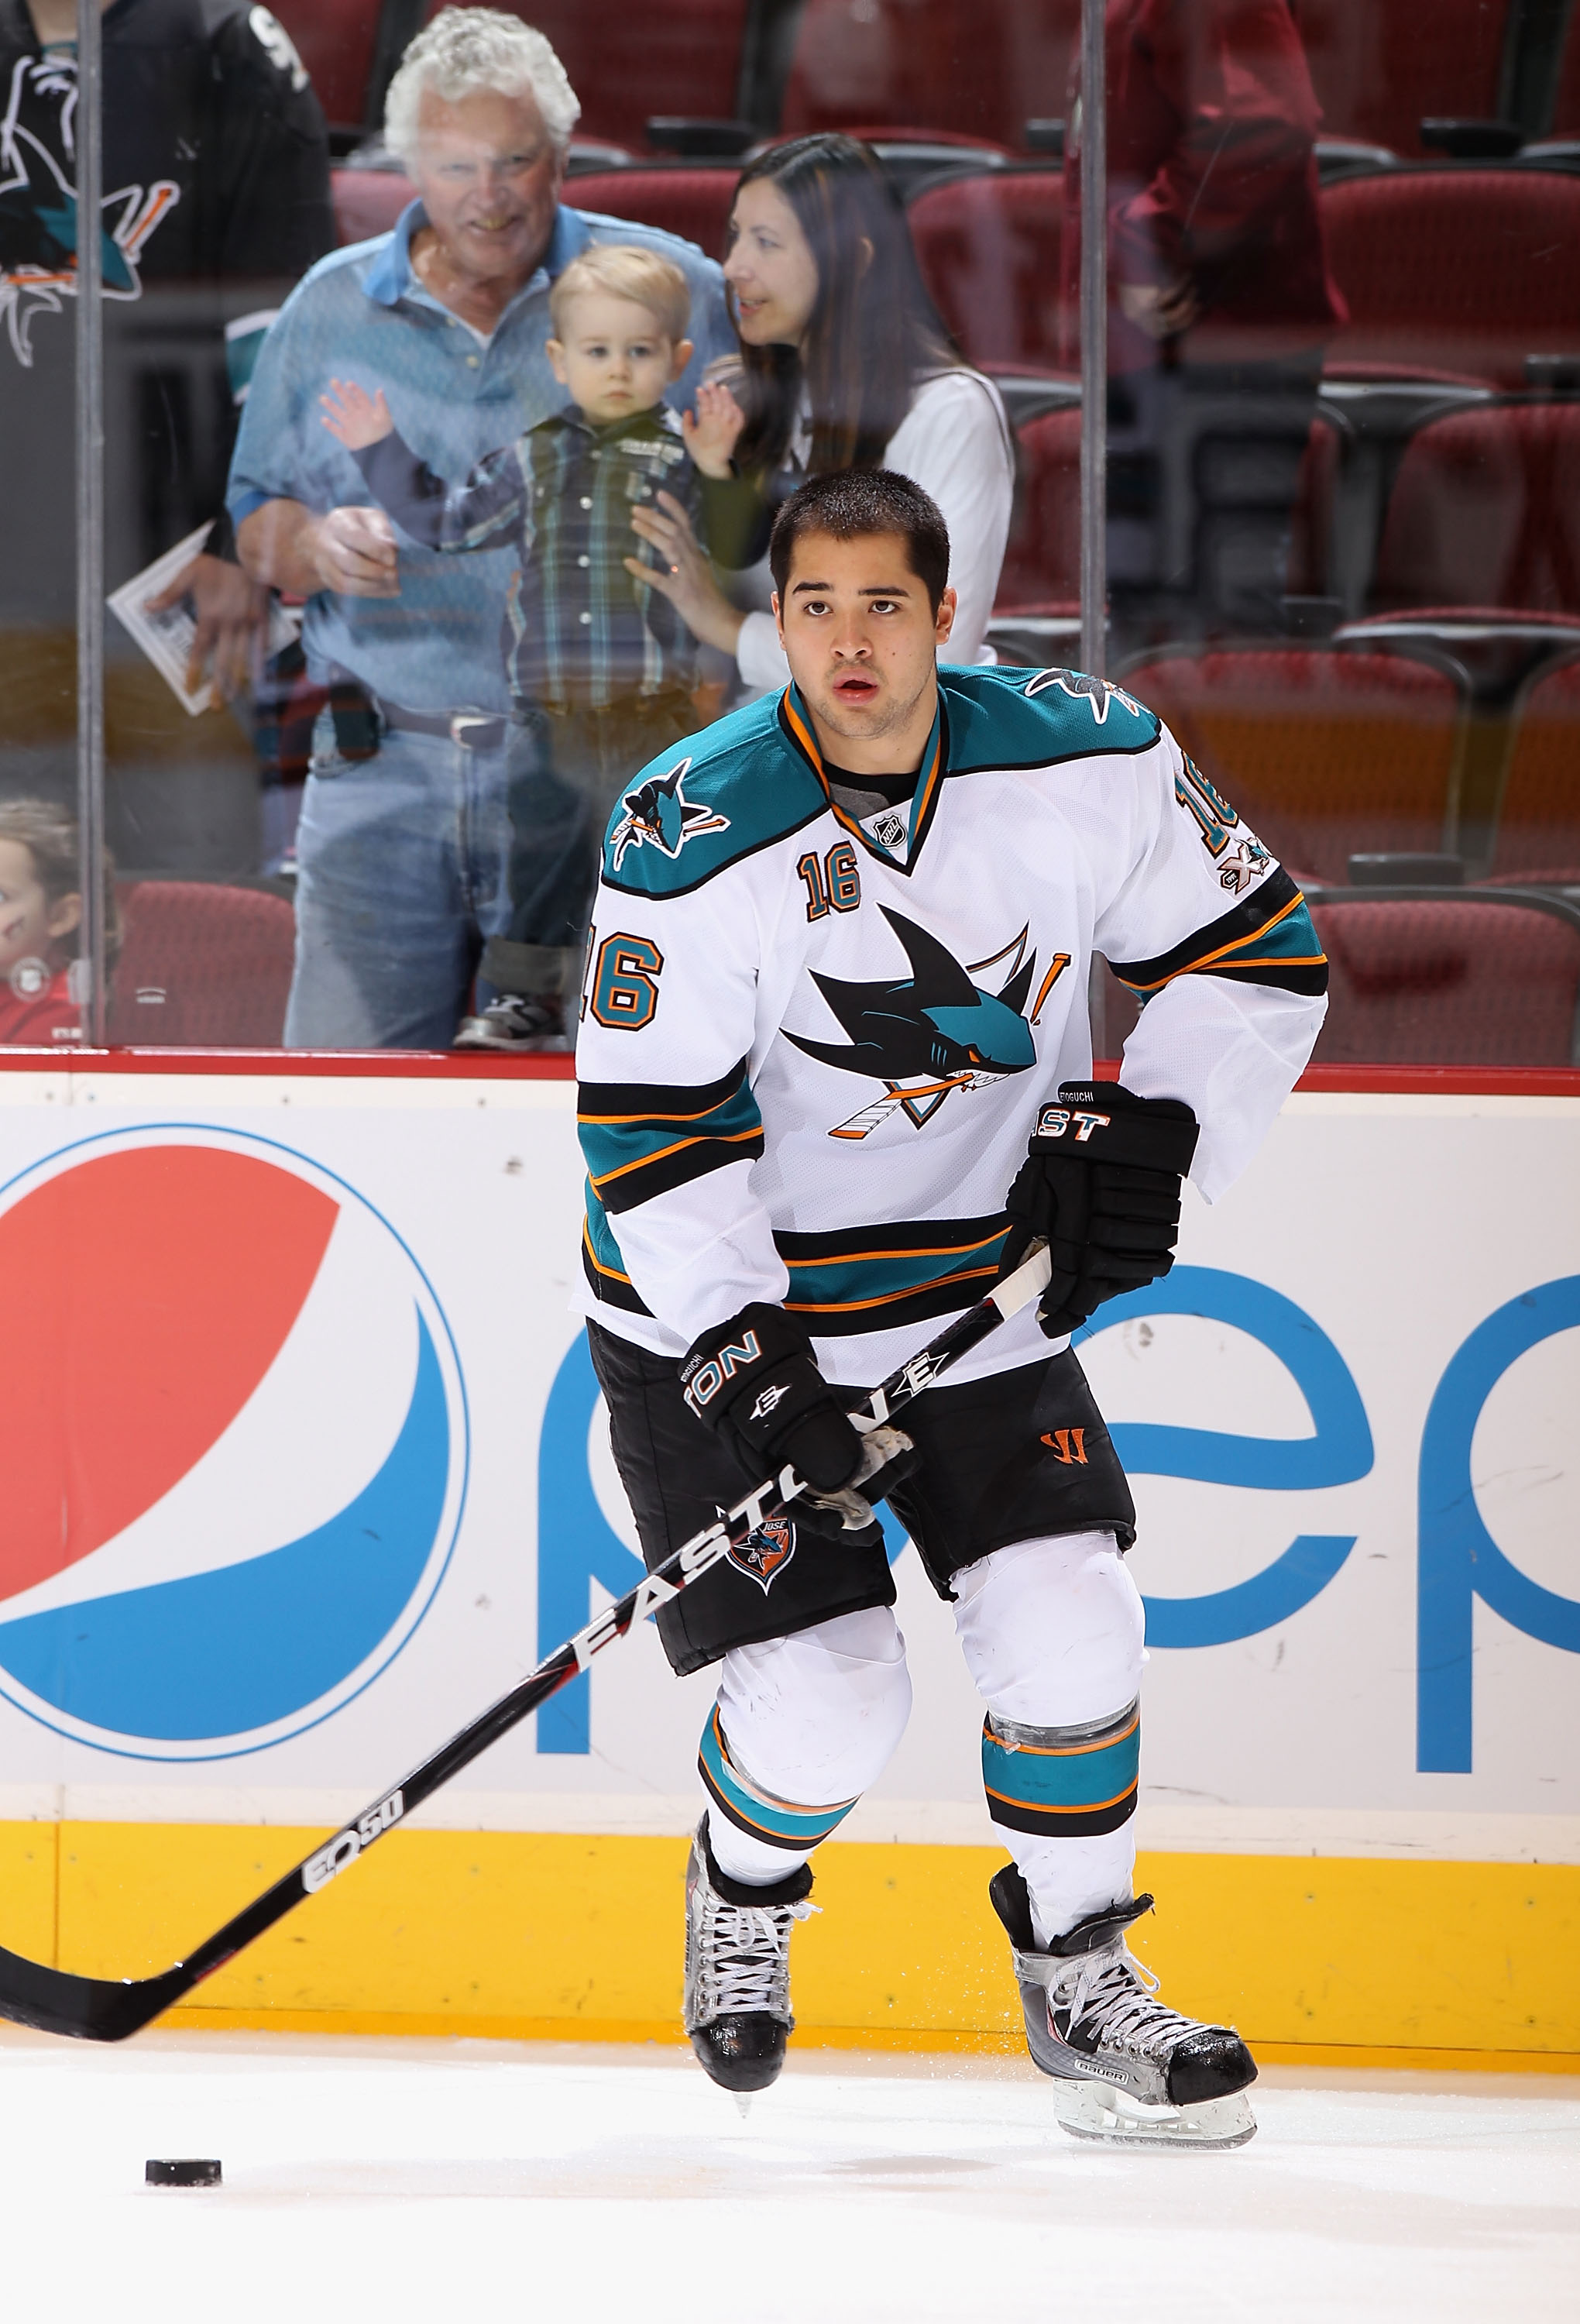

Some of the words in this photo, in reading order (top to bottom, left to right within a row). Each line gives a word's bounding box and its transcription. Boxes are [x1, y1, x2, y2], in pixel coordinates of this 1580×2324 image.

[881, 819, 899, 844] NHL
[796, 840, 861, 923] 16
[579, 926, 665, 1031] 6
[763, 1521, 786, 1532] JOSE
